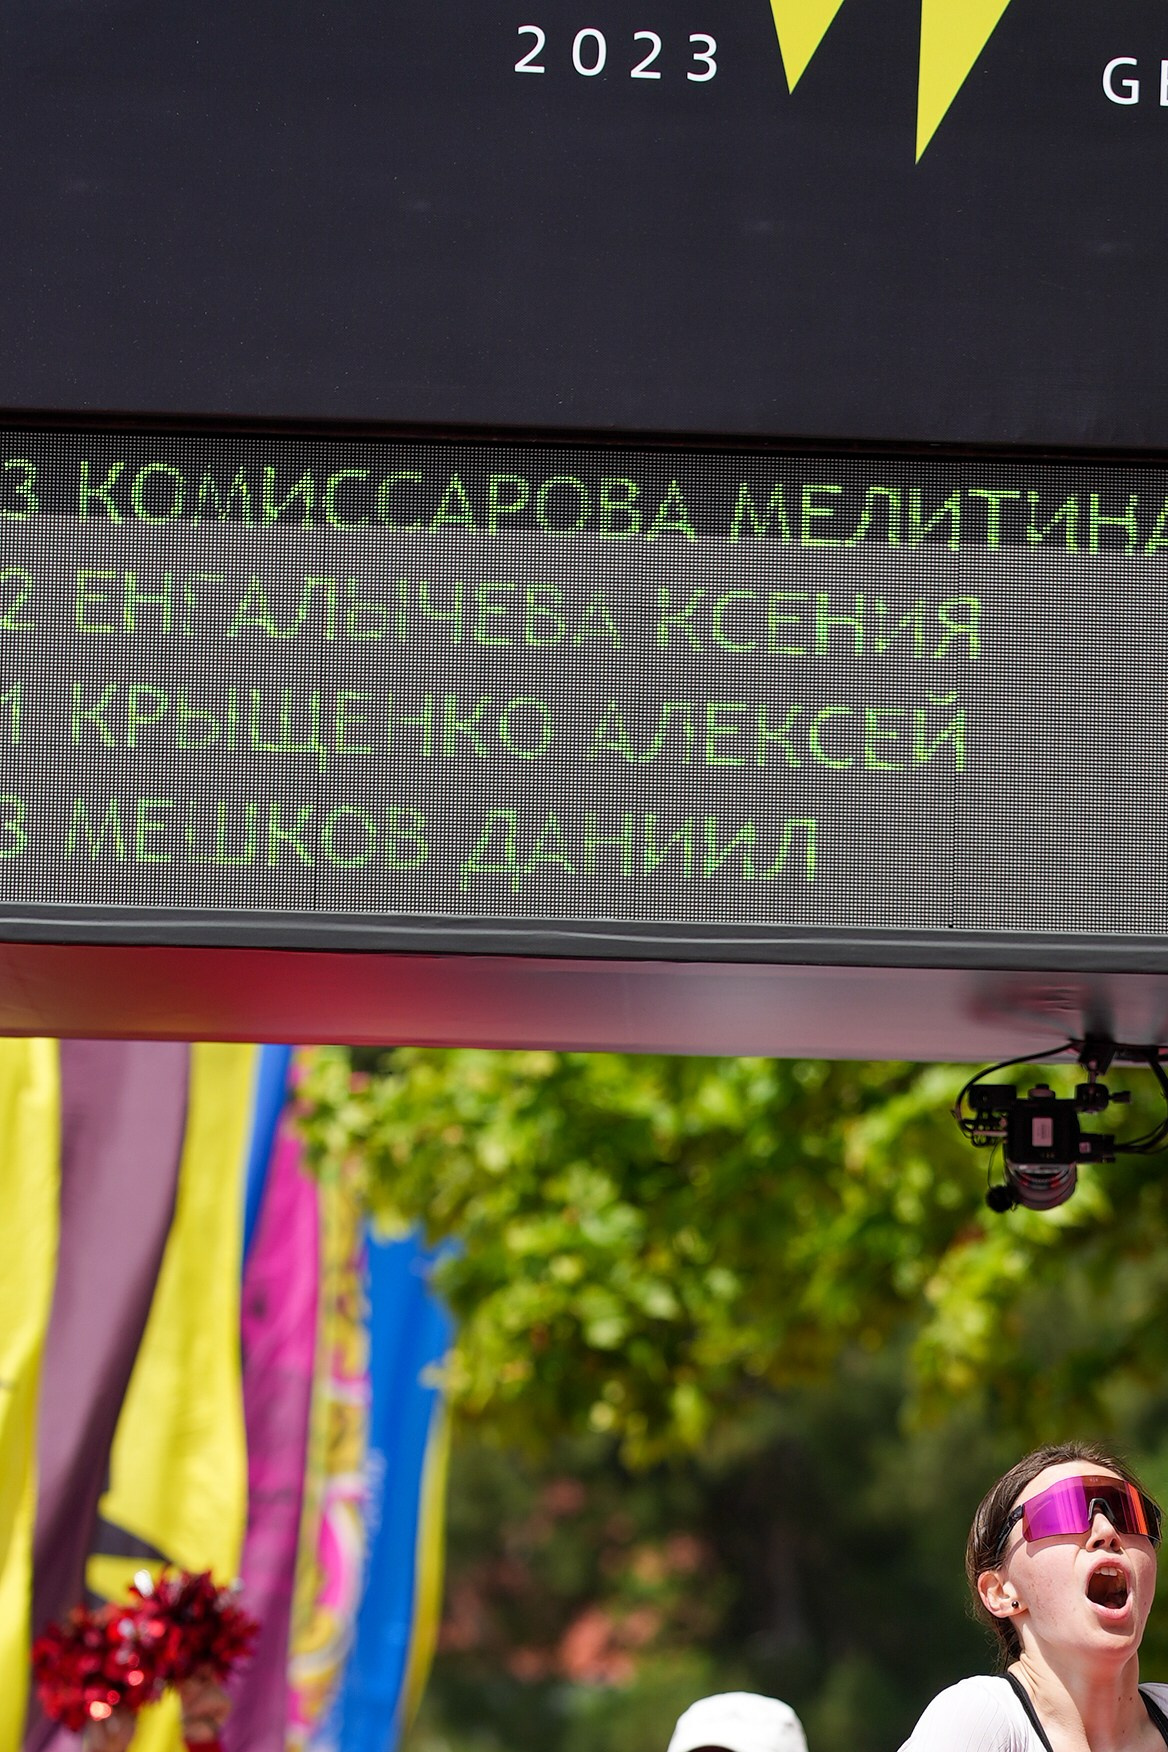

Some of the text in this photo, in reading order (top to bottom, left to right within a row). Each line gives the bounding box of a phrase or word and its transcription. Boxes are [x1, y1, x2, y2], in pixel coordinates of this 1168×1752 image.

[515, 26, 716, 82] 2023
[78, 460, 696, 541] КОМИССАРОВА
[75, 570, 622, 647] ЕНГАЛЫЧЕВА
[657, 588, 982, 659] КСЕНИЯ
[72, 683, 554, 772] КРЫЩЕНКО
[594, 691, 967, 771] АЛЕКСЕЙ
[64, 796, 430, 870] МЕШКОВ
[459, 807, 818, 892] ДАНИИЛ
